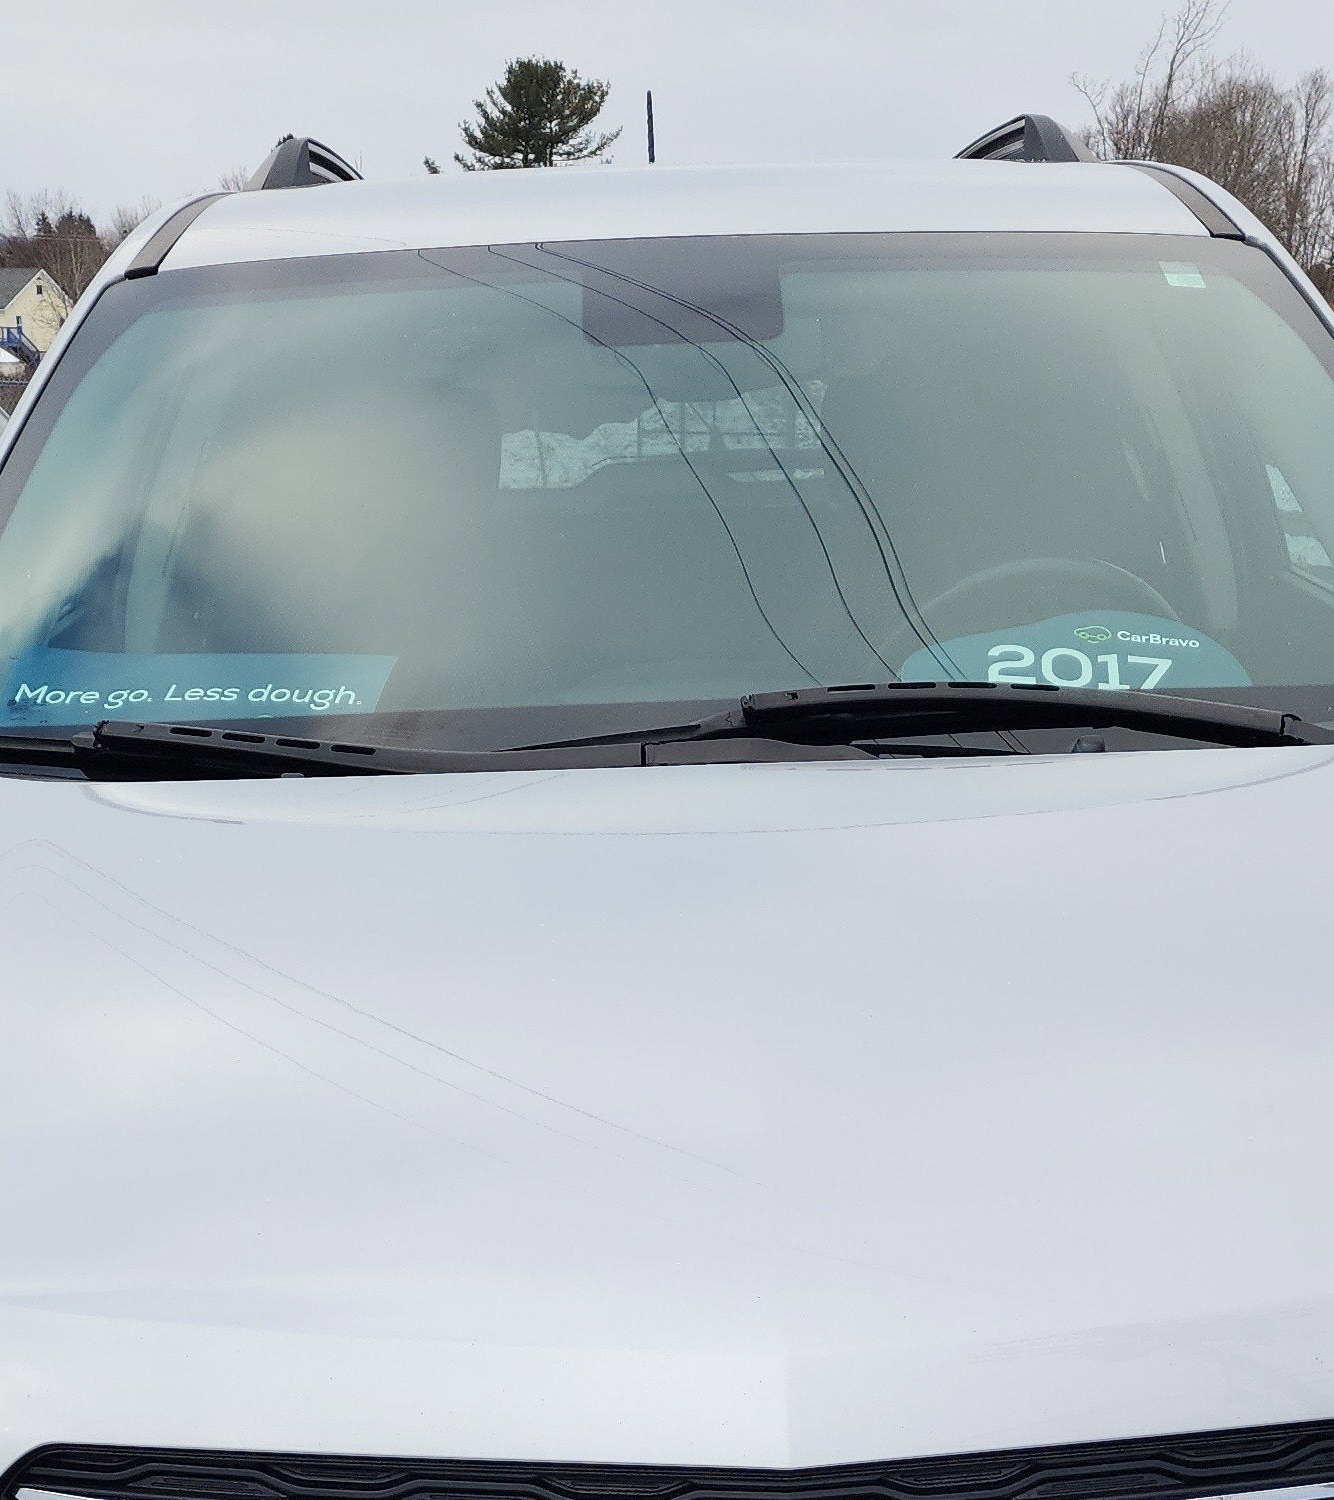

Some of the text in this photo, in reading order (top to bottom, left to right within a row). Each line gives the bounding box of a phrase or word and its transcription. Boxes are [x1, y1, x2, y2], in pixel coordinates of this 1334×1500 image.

[1116, 630, 1200, 648] CarBravo
[987, 644, 1173, 690] 2017
[14, 683, 363, 711] More go. Less dough.
